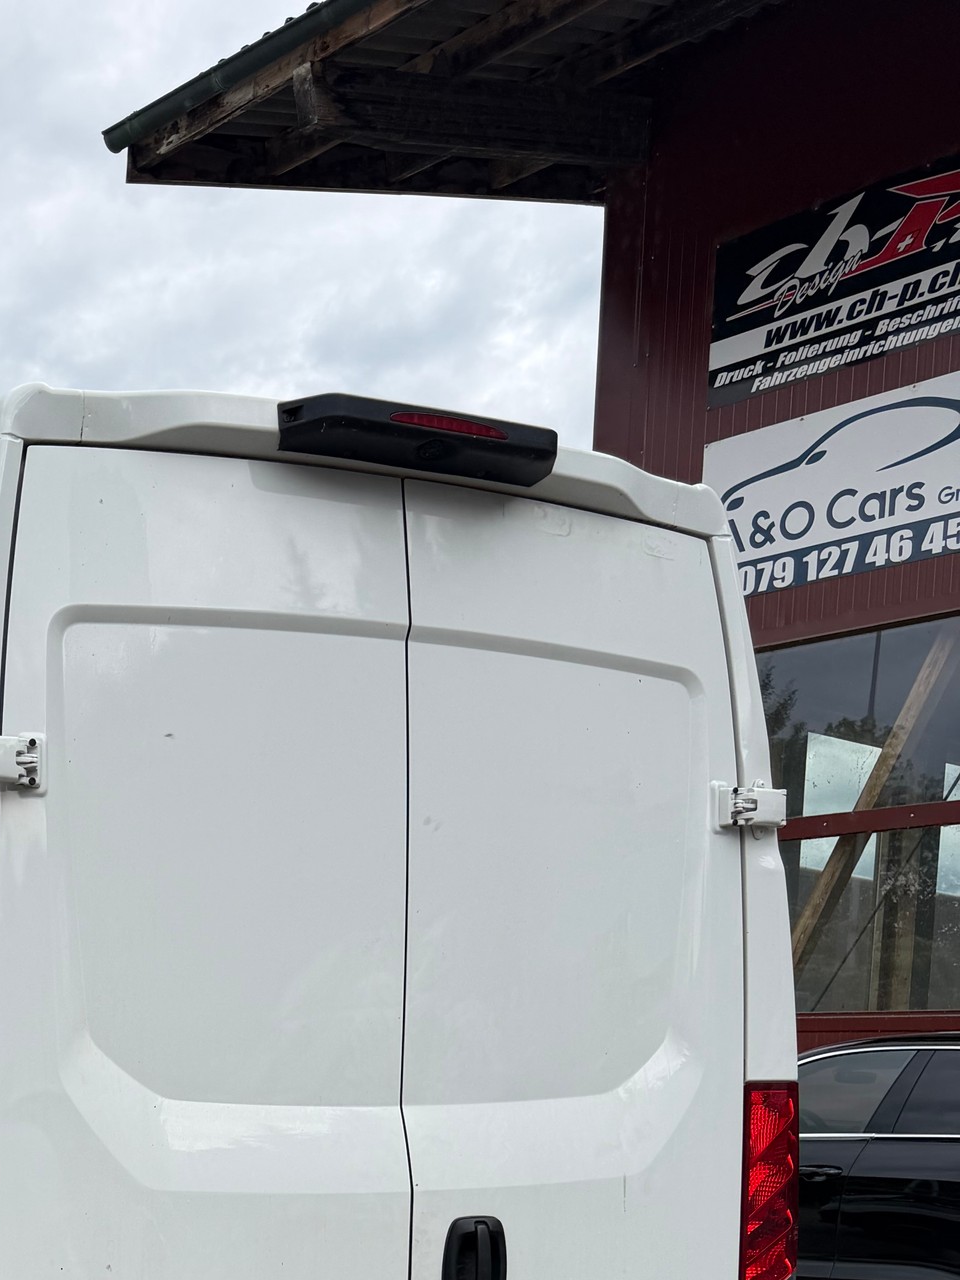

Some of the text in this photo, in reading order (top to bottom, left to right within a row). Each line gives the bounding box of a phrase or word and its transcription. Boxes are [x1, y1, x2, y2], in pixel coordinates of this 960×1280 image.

[774, 250, 863, 318] Design
[713, 359, 765, 388] Druck
[775, 329, 862, 369] Folierung
[874, 294, 960, 337] Beschrif
[826, 481, 925, 530] Cars
[938, 485, 960, 505] G
[739, 517, 960, 597] 079 127 46 45
